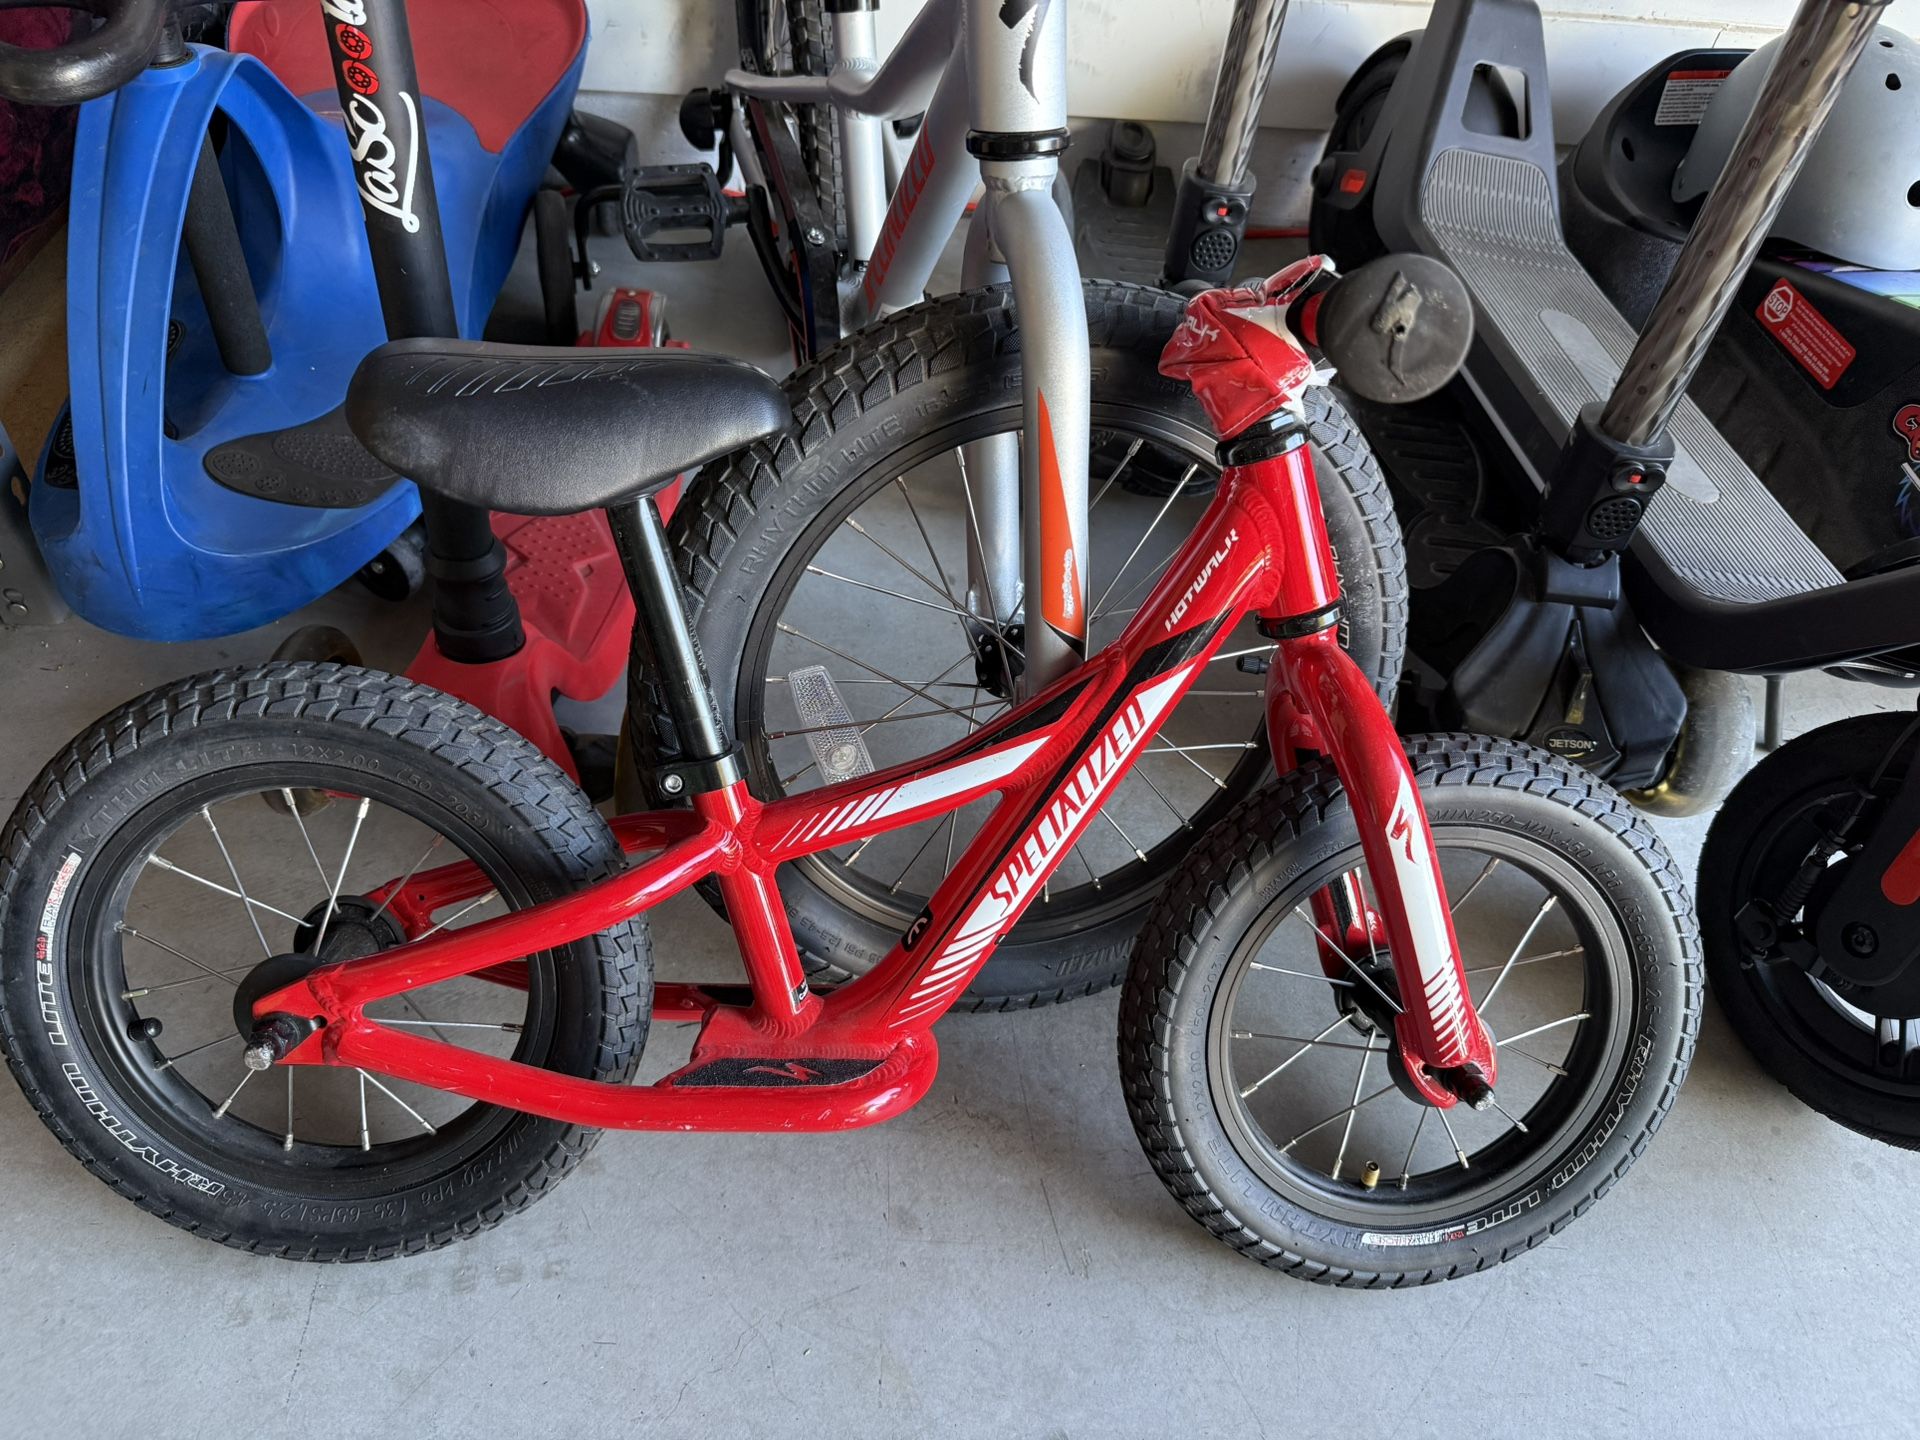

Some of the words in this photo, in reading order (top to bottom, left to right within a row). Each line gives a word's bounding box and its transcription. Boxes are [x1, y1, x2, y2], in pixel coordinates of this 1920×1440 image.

[1767, 293, 1789, 316] STOP
[1164, 528, 1239, 632] HOTWALK
[1549, 738, 1592, 749] JETSON
[991, 696, 1145, 917] SPECIALIZED
[36, 960, 68, 1046] LITE
[62, 1062, 226, 1196] RHYTHM
[1553, 1033, 1651, 1189] RHYTHM
[1466, 1190, 1541, 1236] LITE
